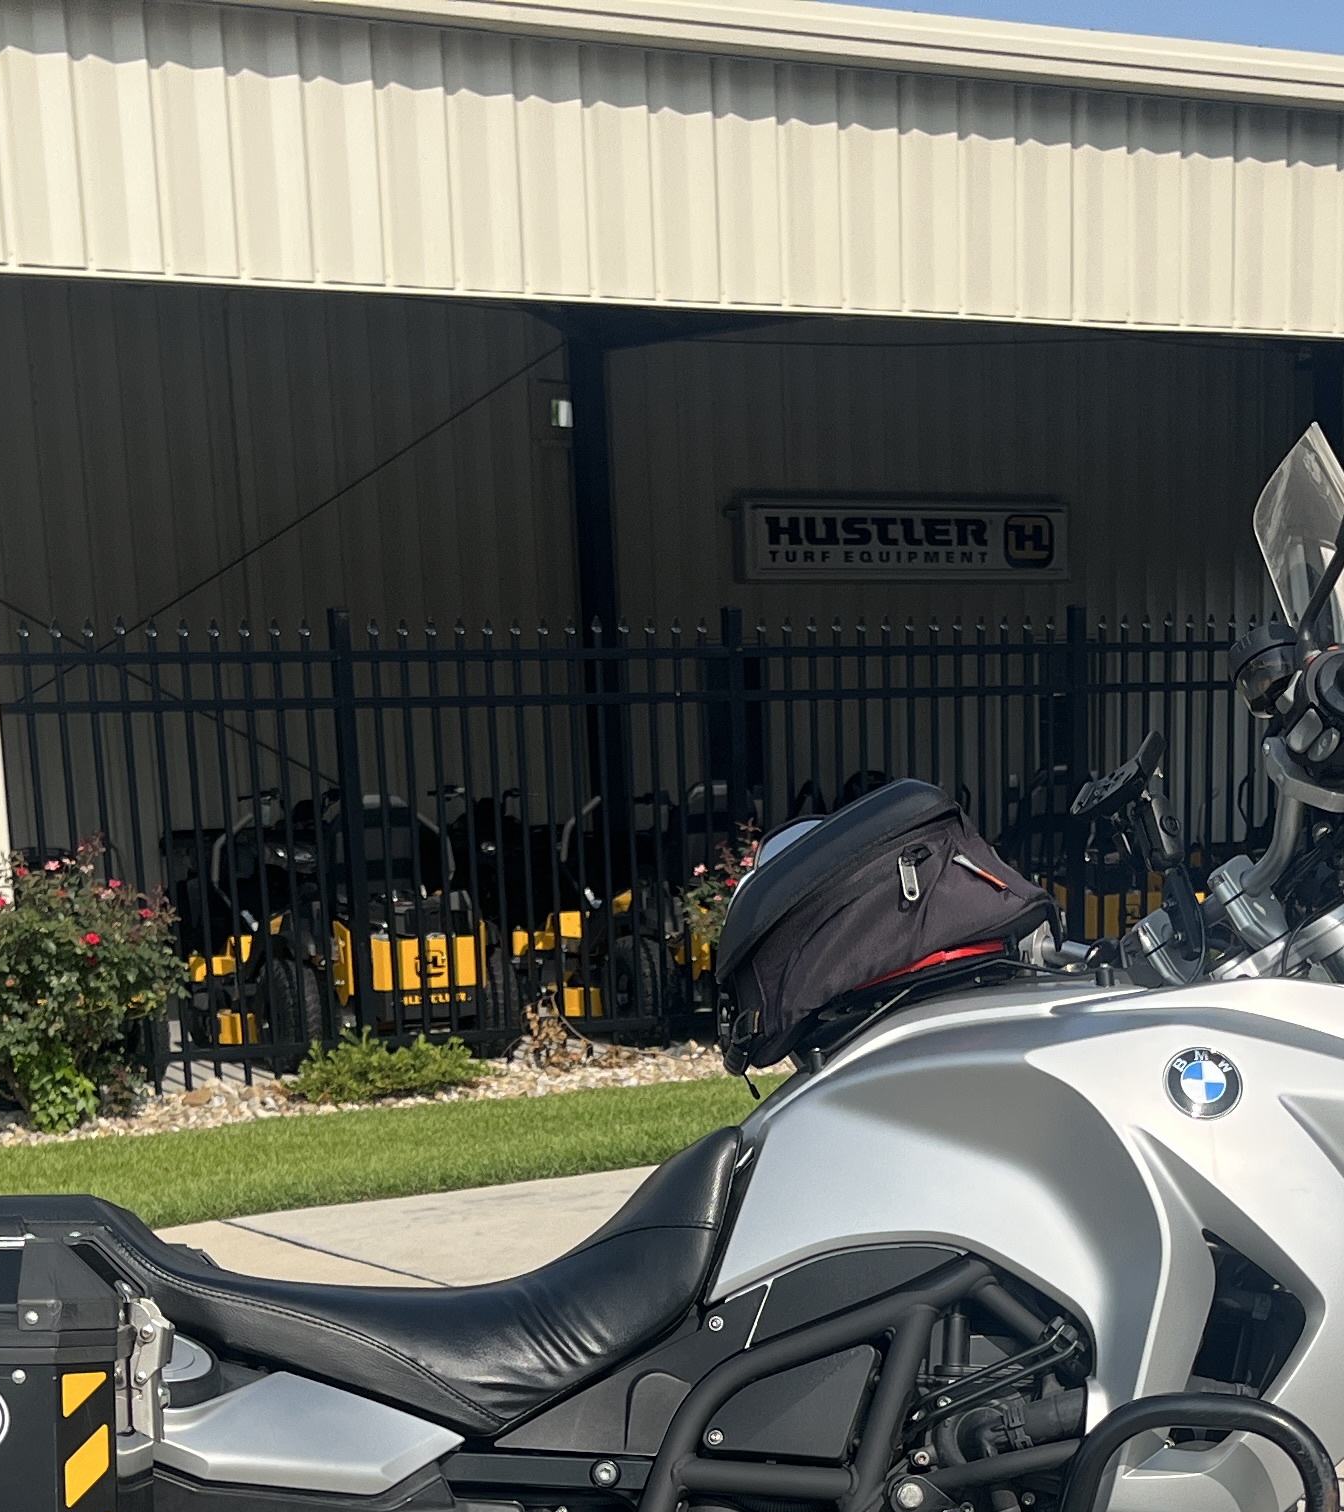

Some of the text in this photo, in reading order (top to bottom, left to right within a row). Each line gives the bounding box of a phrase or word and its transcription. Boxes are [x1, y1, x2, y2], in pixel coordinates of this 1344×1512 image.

[765, 516, 989, 547] HUSTLER
[770, 551, 988, 565] TURF EQUIPMENT
[1172, 1050, 1233, 1073] BMW
